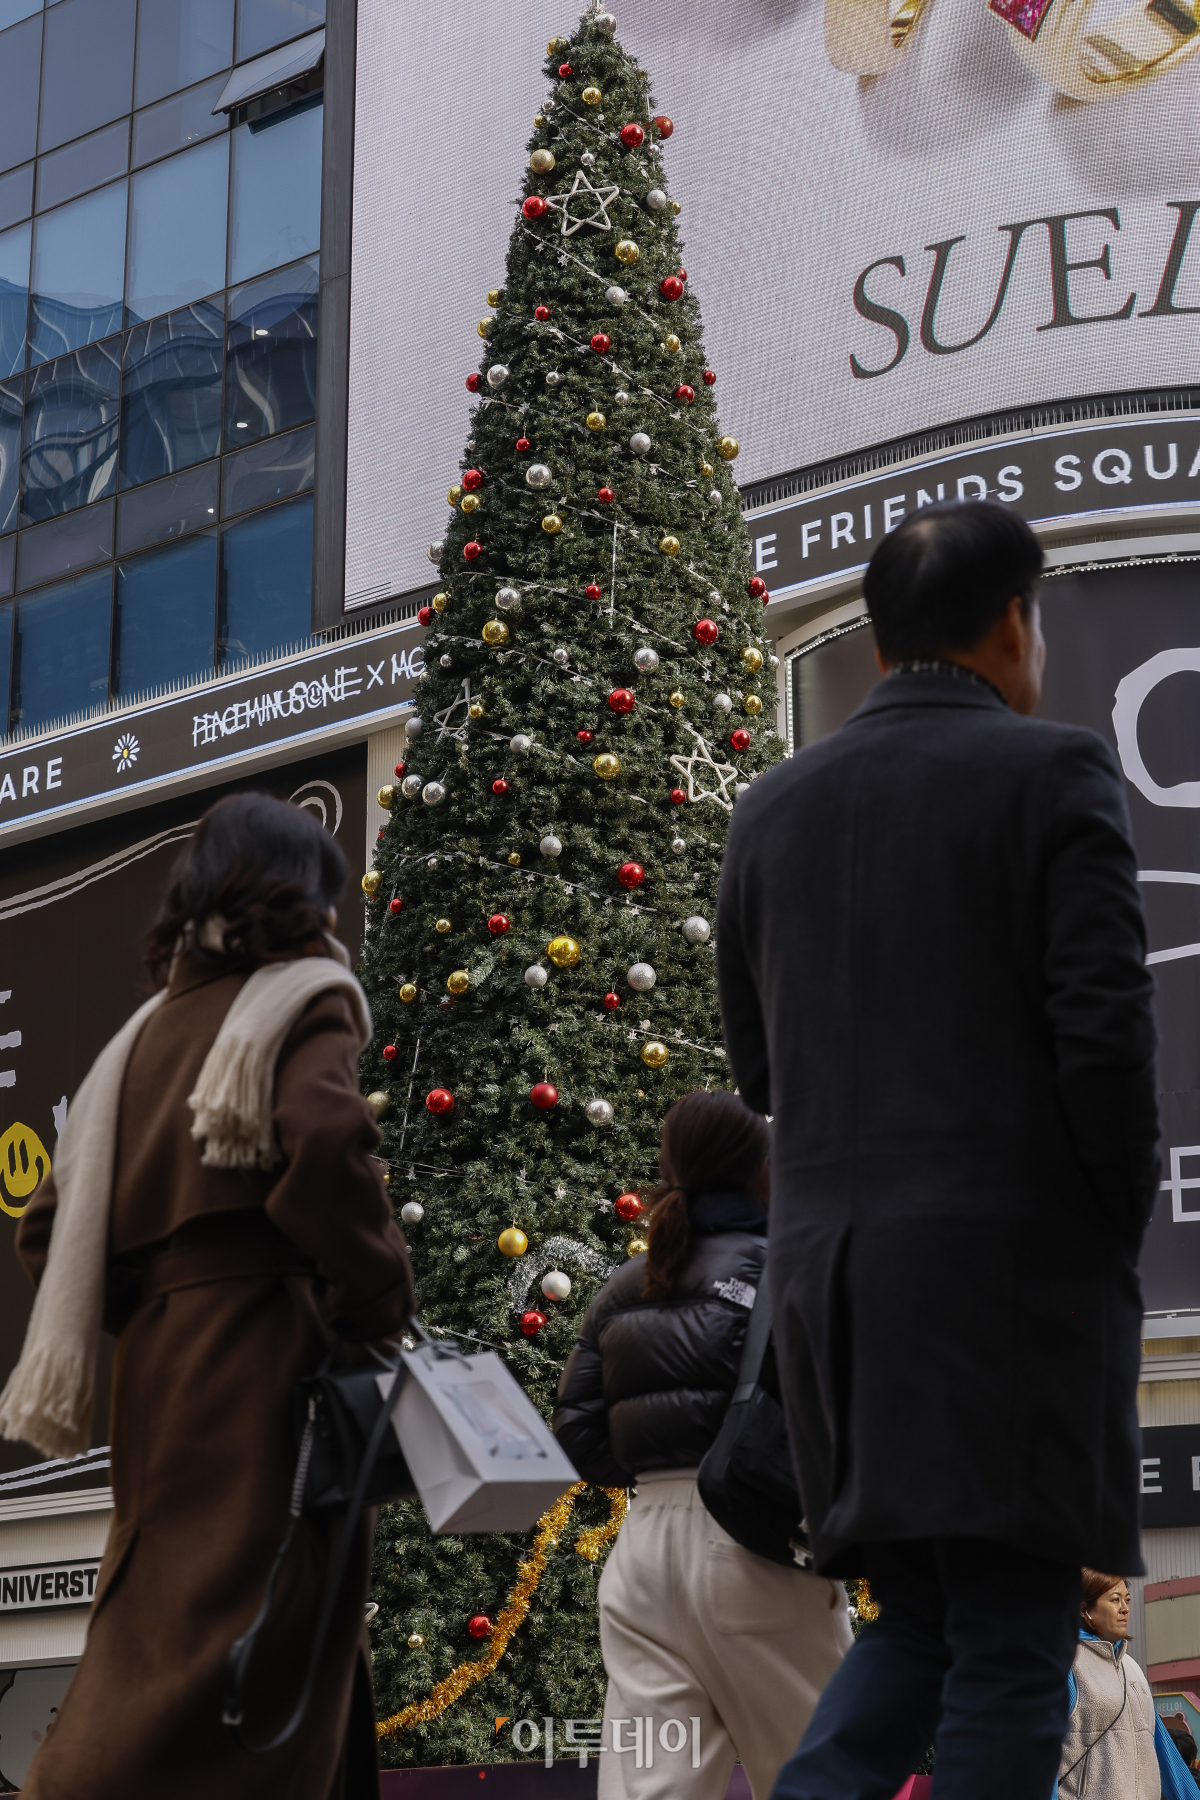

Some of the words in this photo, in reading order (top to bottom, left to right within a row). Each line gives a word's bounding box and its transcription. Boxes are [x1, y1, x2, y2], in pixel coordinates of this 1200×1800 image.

[801, 465, 1024, 559] FRIENDS
[0, 756, 63, 804] ARE
[366, 660, 385, 691] X
[0, 1568, 98, 1604] NIVERST
[1156, 1701, 1182, 1712] HELLO!
